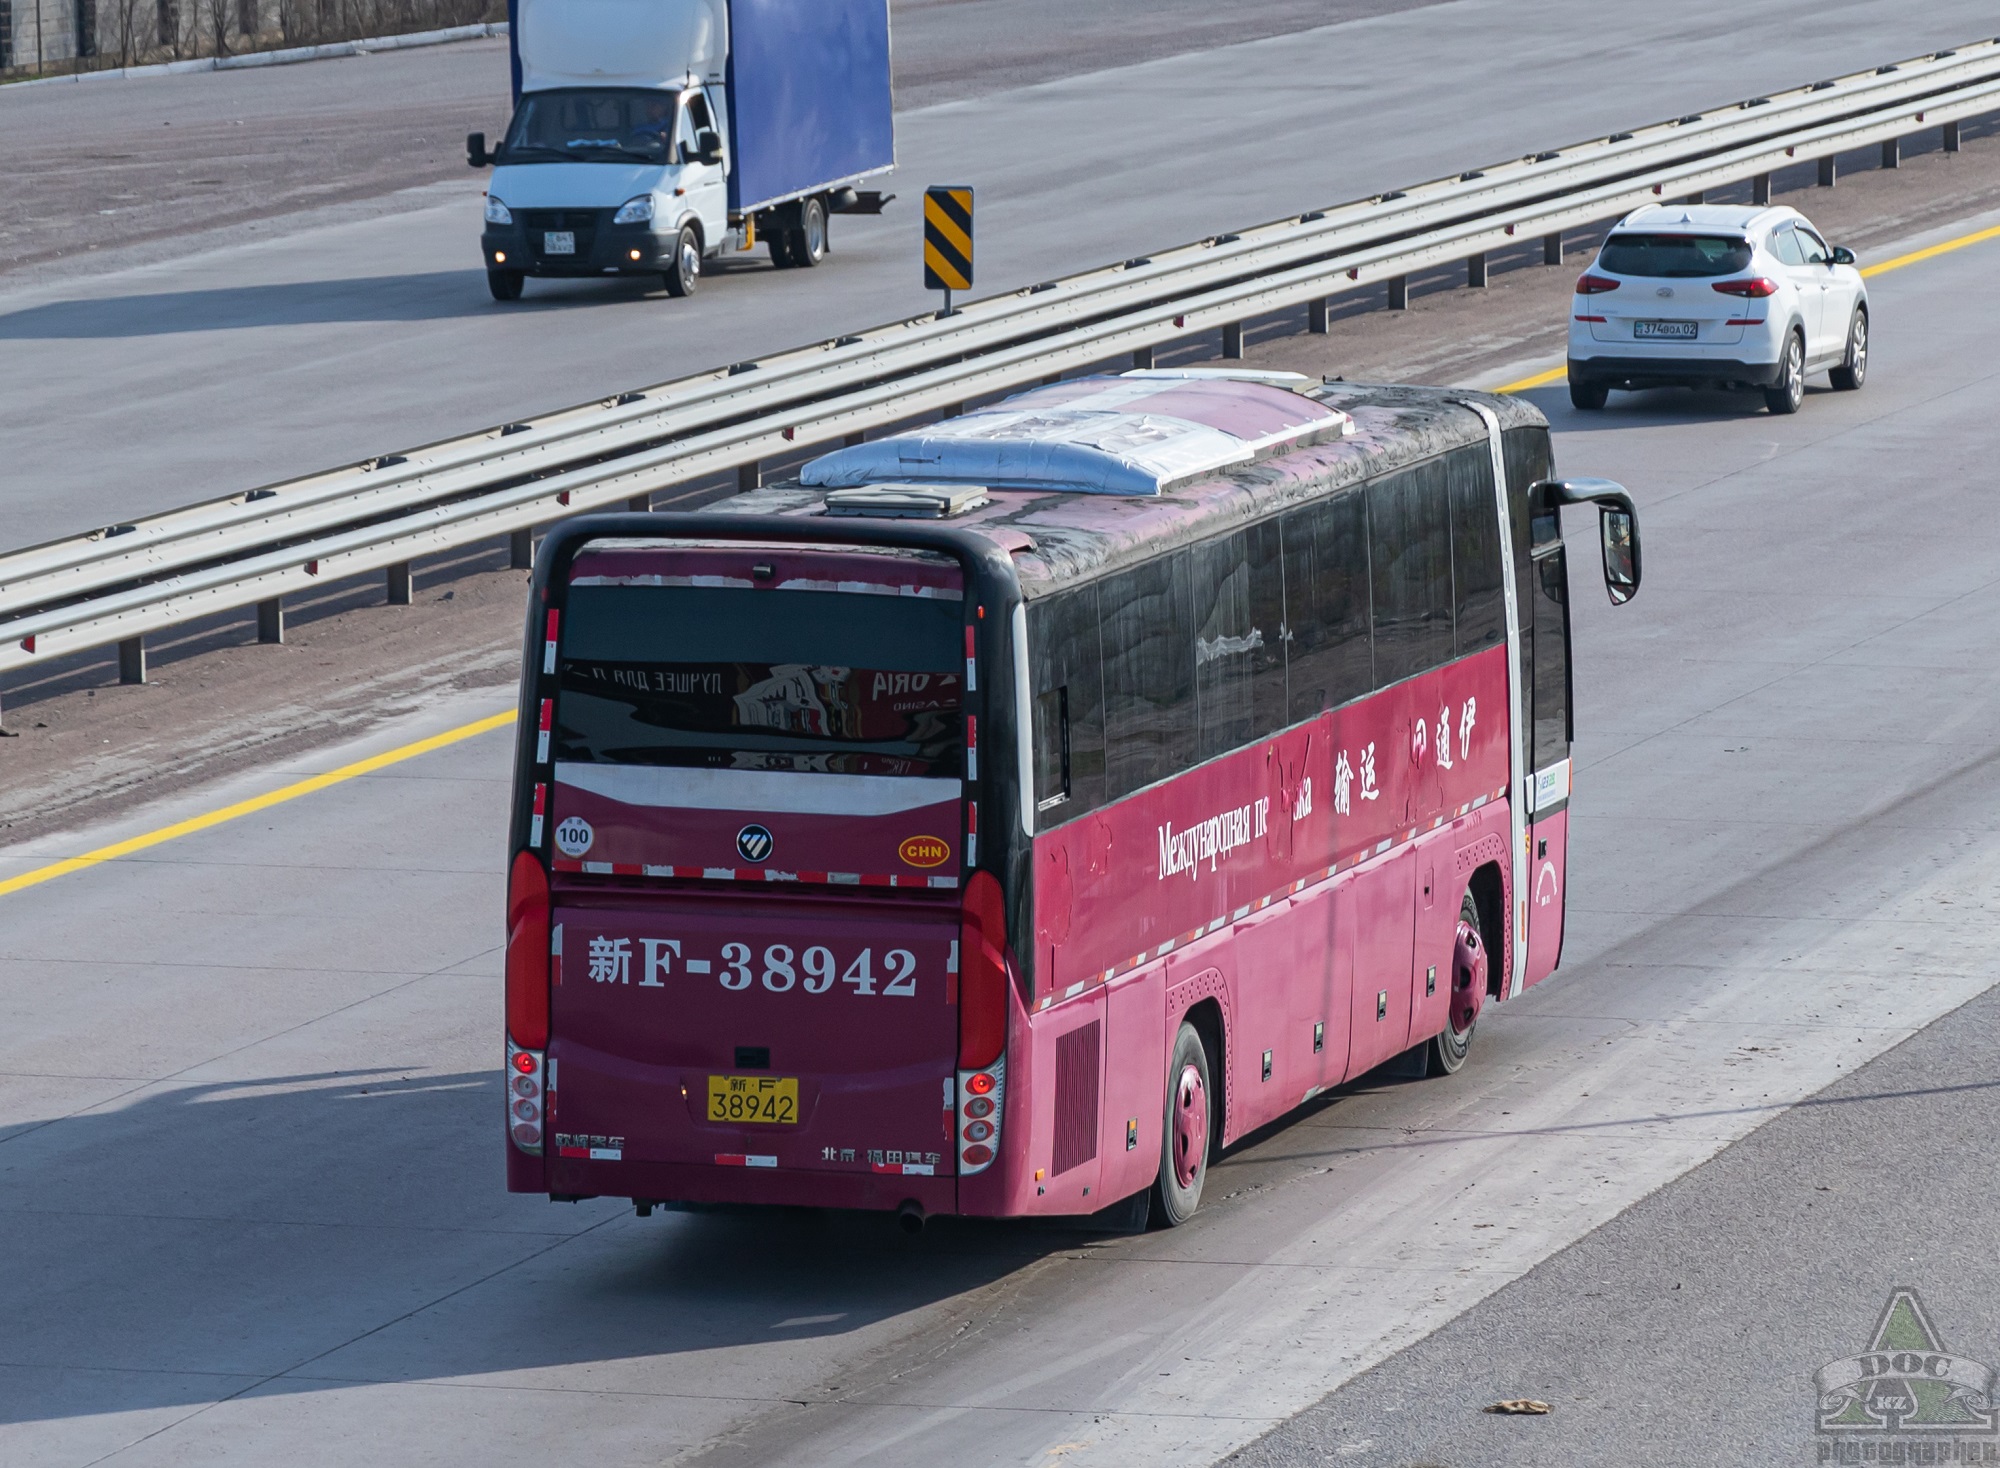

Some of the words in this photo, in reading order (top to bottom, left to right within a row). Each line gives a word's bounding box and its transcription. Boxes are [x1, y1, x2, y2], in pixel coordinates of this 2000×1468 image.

[1683, 324, 1696, 335] 02
[560, 828, 589, 844] 100
[1158, 805, 1251, 882] Международная
[907, 845, 942, 857] CHN
[712, 1093, 793, 1121] 38942
